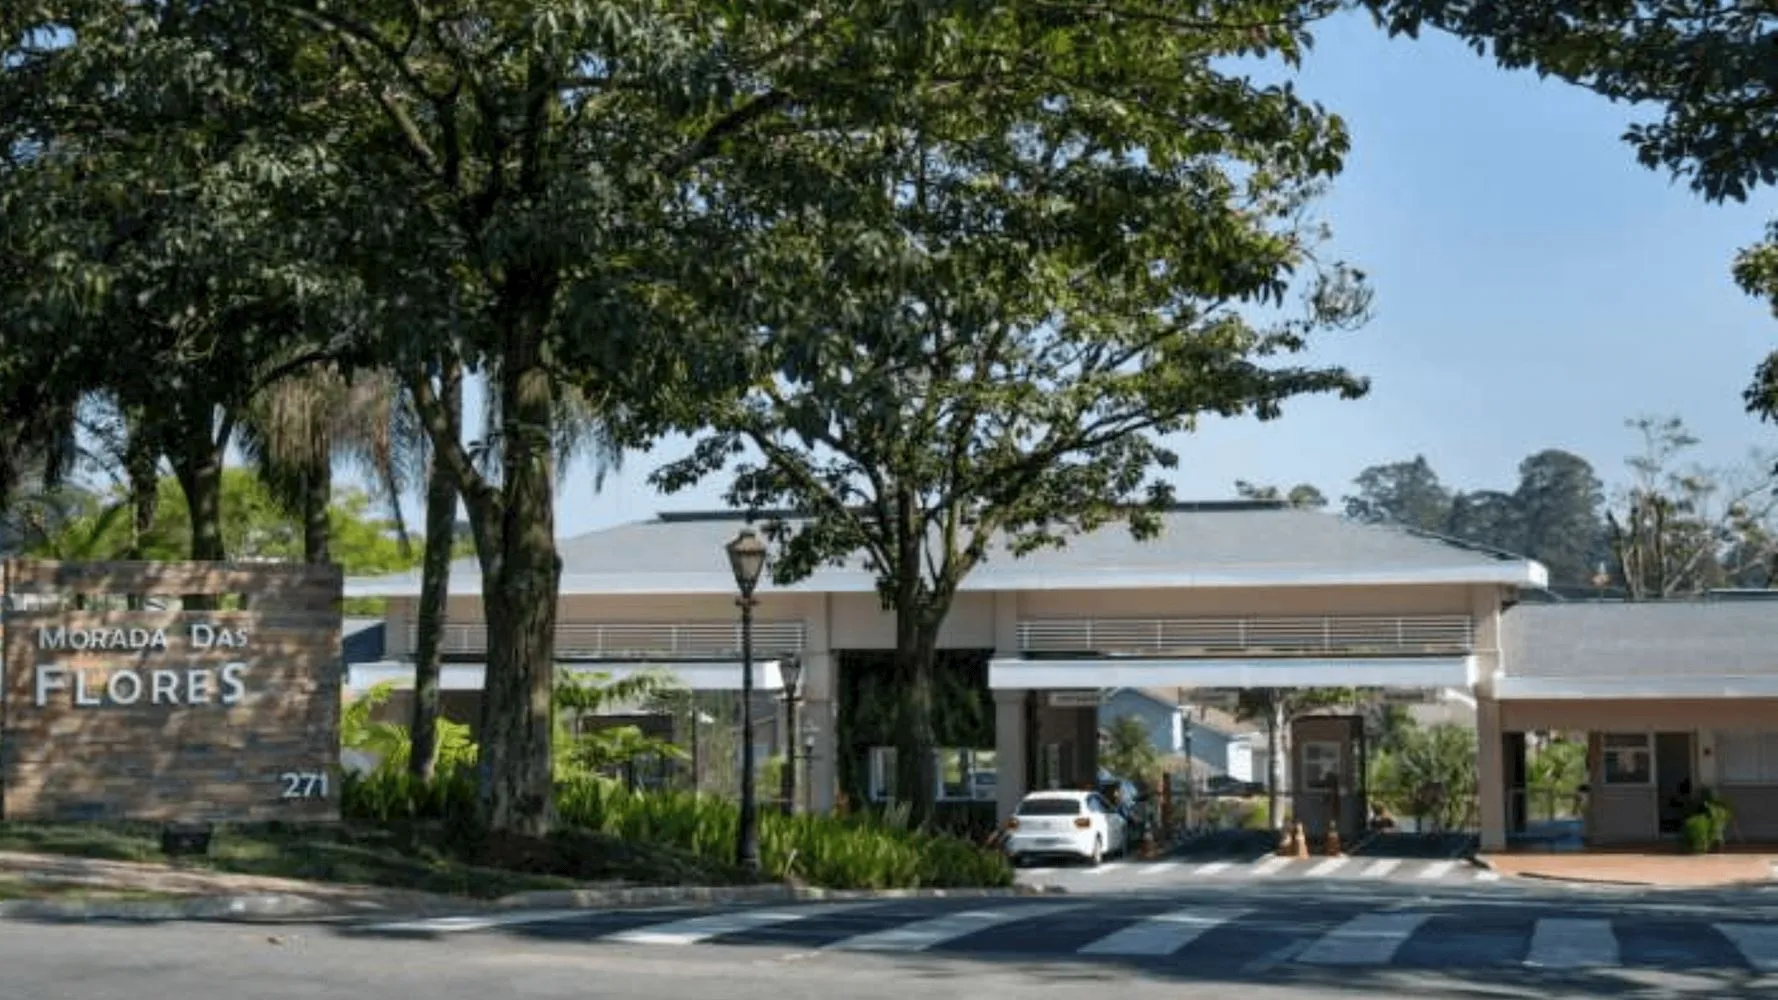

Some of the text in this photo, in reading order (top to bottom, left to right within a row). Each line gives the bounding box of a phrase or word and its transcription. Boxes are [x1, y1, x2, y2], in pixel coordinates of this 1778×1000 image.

[38, 623, 248, 649] MORADA DAS
[36, 661, 248, 706] FLORES
[281, 771, 328, 798] 271
